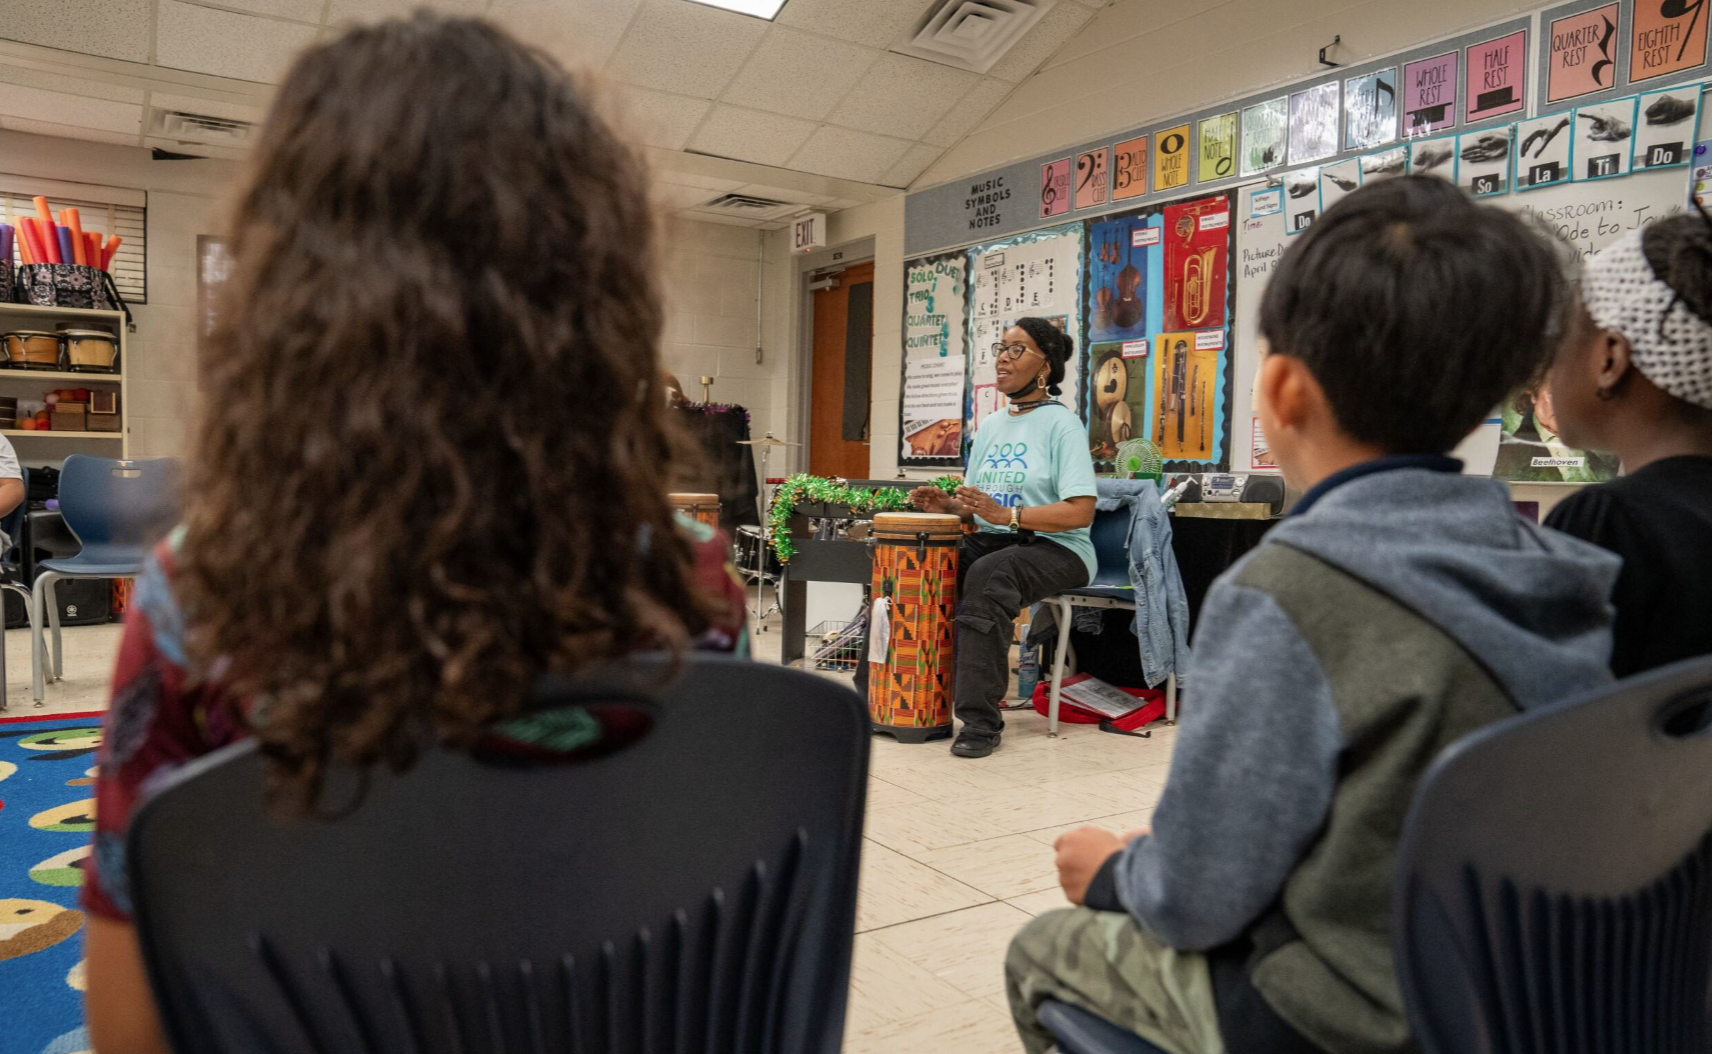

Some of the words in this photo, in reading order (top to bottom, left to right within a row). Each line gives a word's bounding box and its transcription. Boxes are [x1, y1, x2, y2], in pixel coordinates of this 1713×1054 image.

[1553, 24, 1600, 52] QUARTER
[1638, 22, 1681, 51] EIGHTH
[1484, 45, 1509, 70] HALF
[1562, 46, 1588, 68] REST
[1643, 45, 1671, 69] REST
[1416, 64, 1448, 88] WHOLE
[1484, 65, 1509, 90] REST
[1419, 85, 1442, 106] REST
[1204, 141, 1223, 160] NOTE
[1652, 147, 1673, 165] Do
[1161, 153, 1182, 171] WHOLE
[1596, 159, 1610, 175] Ti
[1163, 170, 1179, 187] NOTE
[1535, 168, 1551, 184] La
[971, 176, 1004, 196] MUSIC
[1477, 179, 1492, 194] So
[965, 188, 1011, 210] SYMBOLS
[976, 204, 997, 218] AND
[969, 213, 1001, 230] NOTES
[1298, 215, 1311, 229] Do
[1597, 216, 1620, 237] to
[796, 218, 814, 248] EXIT
[910, 270, 934, 284] SOLO
[1244, 262, 1267, 278] April
[909, 289, 930, 304] TRIO
[907, 314, 946, 327] QUARTET
[907, 332, 944, 348] QUINTET
[1532, 458, 1579, 467] Beethoven
[990, 492, 1023, 508] SIC
